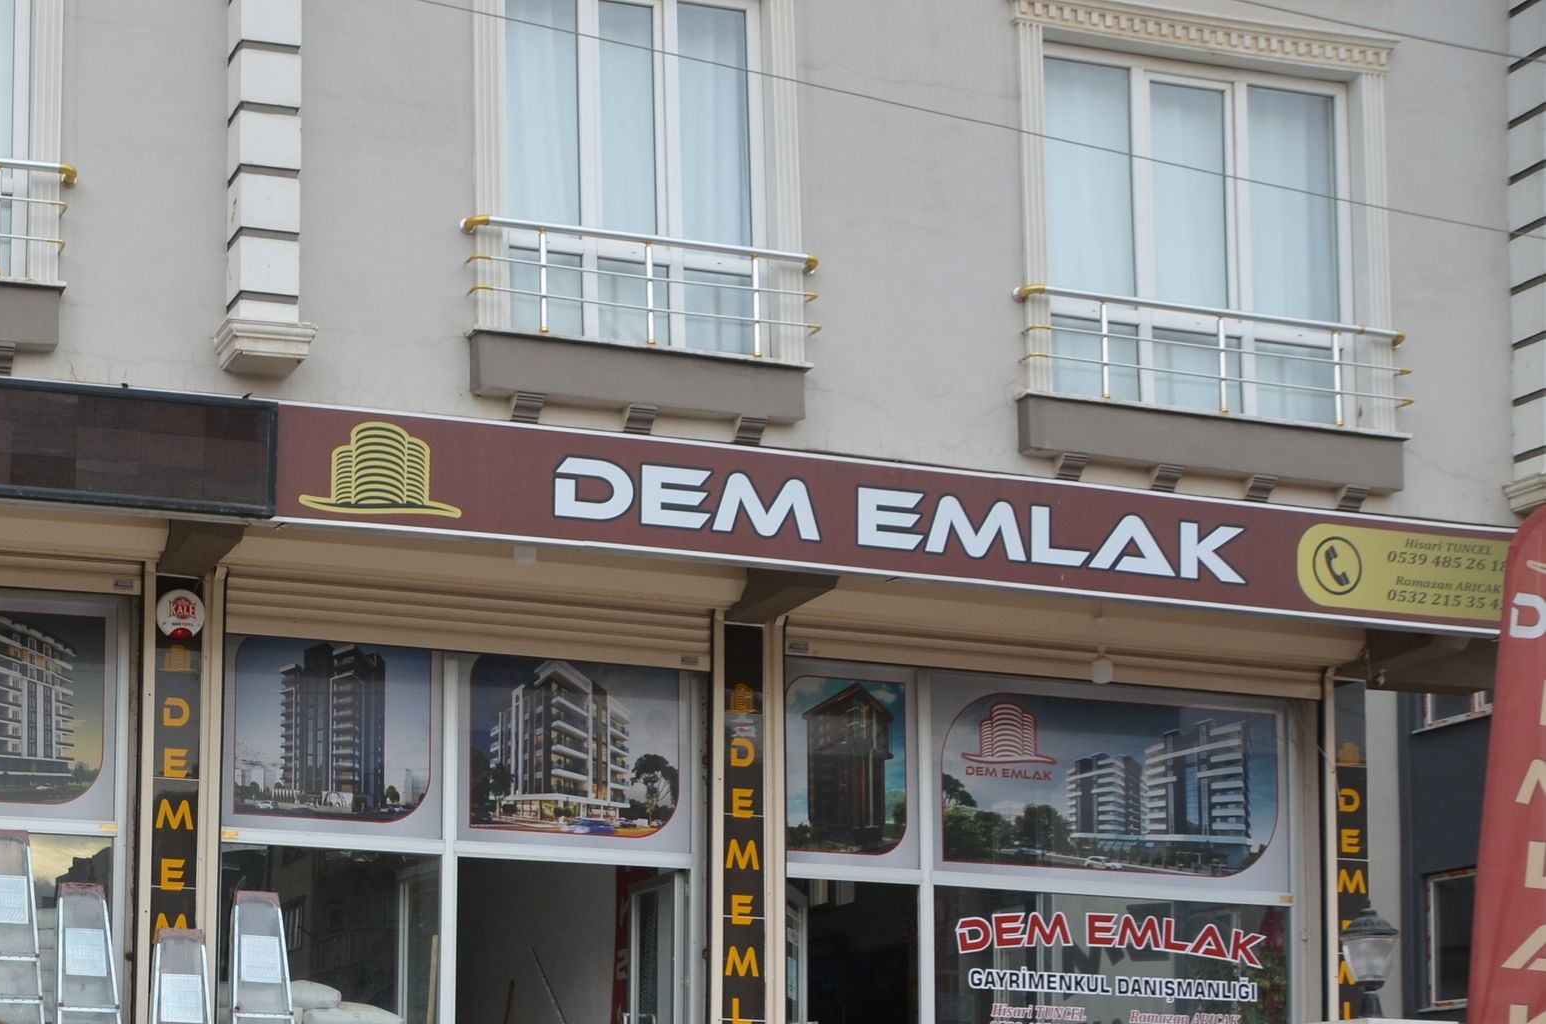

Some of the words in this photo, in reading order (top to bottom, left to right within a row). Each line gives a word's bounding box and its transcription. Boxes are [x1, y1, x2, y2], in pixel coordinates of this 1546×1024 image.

[553, 455, 822, 542] DEM
[856, 485, 1248, 585] EMLAK
[1404, 538, 1443, 552] Hisari
[1446, 542, 1494, 556] TUNCEL
[1386, 550, 1428, 566] 0539
[1431, 555, 1463, 569] 485
[1465, 557, 1486, 571] 26
[1395, 575, 1453, 591] Ramazan
[1455, 581, 1503, 595] ARICAK
[168, 600, 197, 619] KALE
[1386, 588, 1428, 604] 0532
[1430, 592, 1463, 607] 215
[1465, 595, 1486, 609] 35
[1489, 597, 1505, 611] 4
[965, 766, 997, 777] DEM
[1001, 768, 1053, 781] EMLAK
[956, 912, 1073, 953] DEM
[1086, 912, 1267, 969] EMLAK
[968, 966, 1111, 996] GAYRİMENKUL
[1115, 976, 1258, 1003] DANIŞMANLIĞI
[990, 1003, 1034, 1019] Hisari
[1035, 1005, 1087, 1021] TUNCEL
